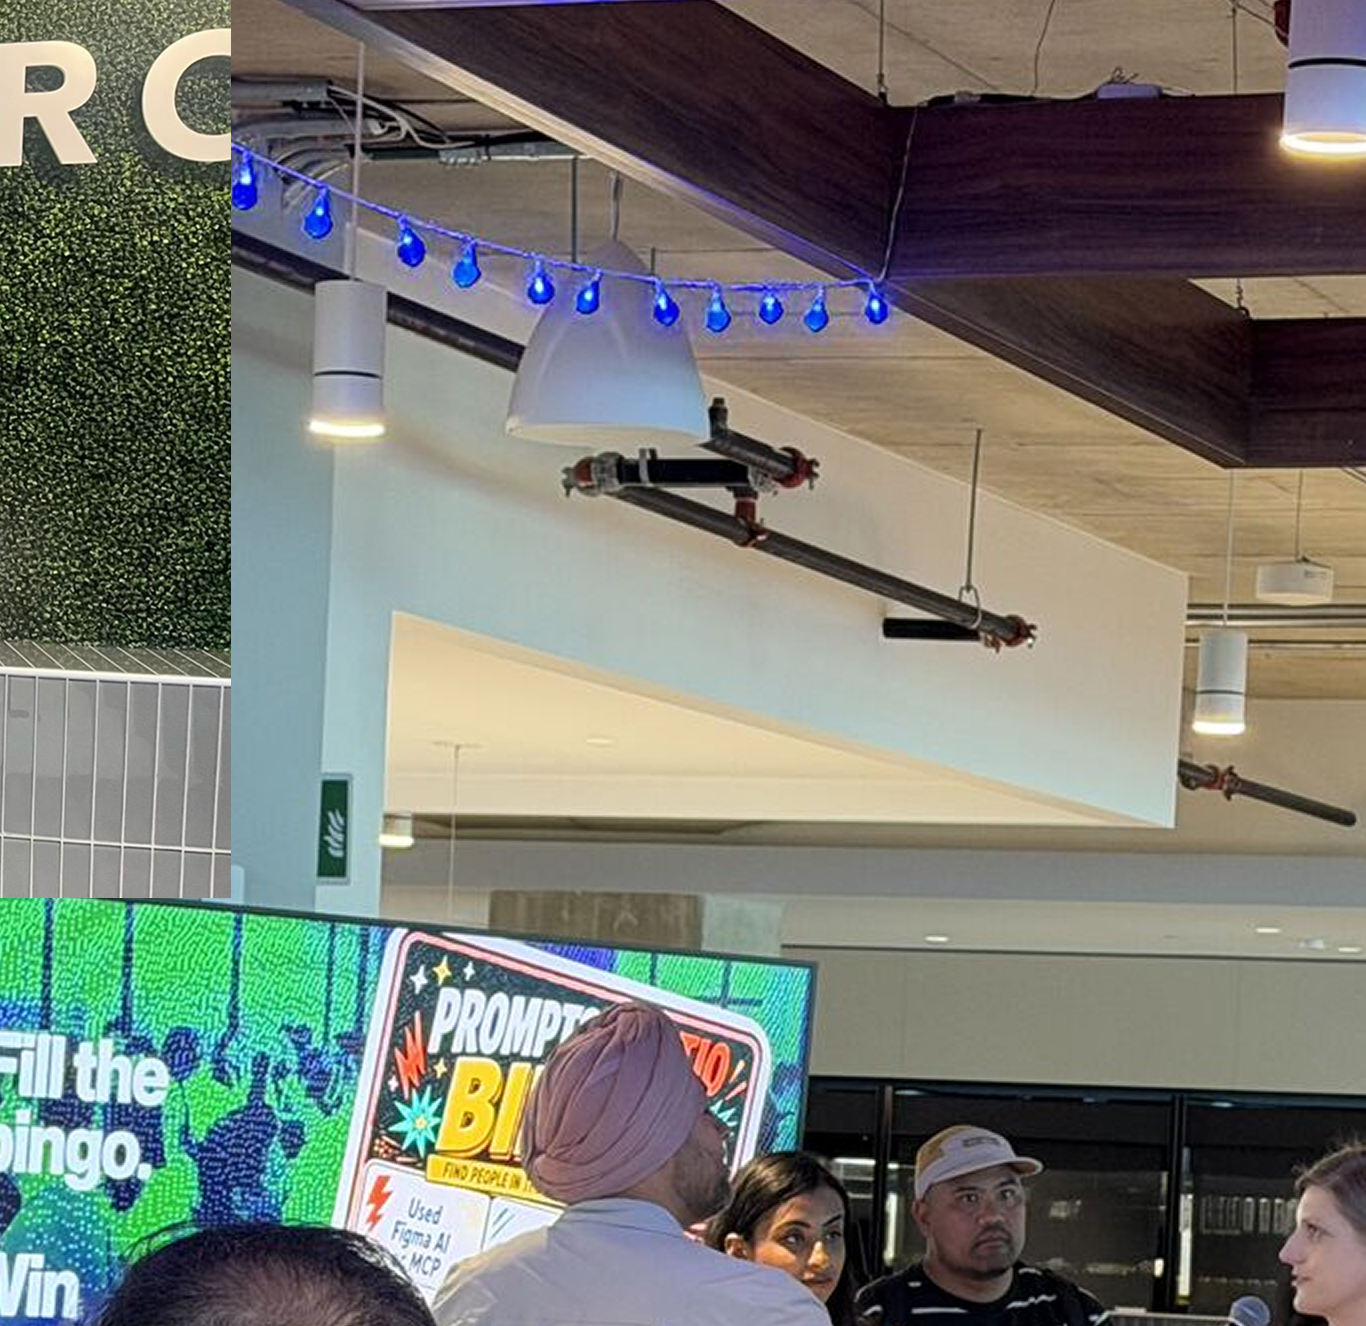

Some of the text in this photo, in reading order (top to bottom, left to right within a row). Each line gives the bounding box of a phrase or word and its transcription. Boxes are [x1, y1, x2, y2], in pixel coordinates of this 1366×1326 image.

[73, 1038, 170, 1107] the
[441, 1161, 469, 1181] FIND
[469, 1165, 509, 1188] PEOPLE
[408, 1197, 444, 1225] Used
[391, 1219, 451, 1254] Figma AI
[409, 1251, 442, 1278] MCP
